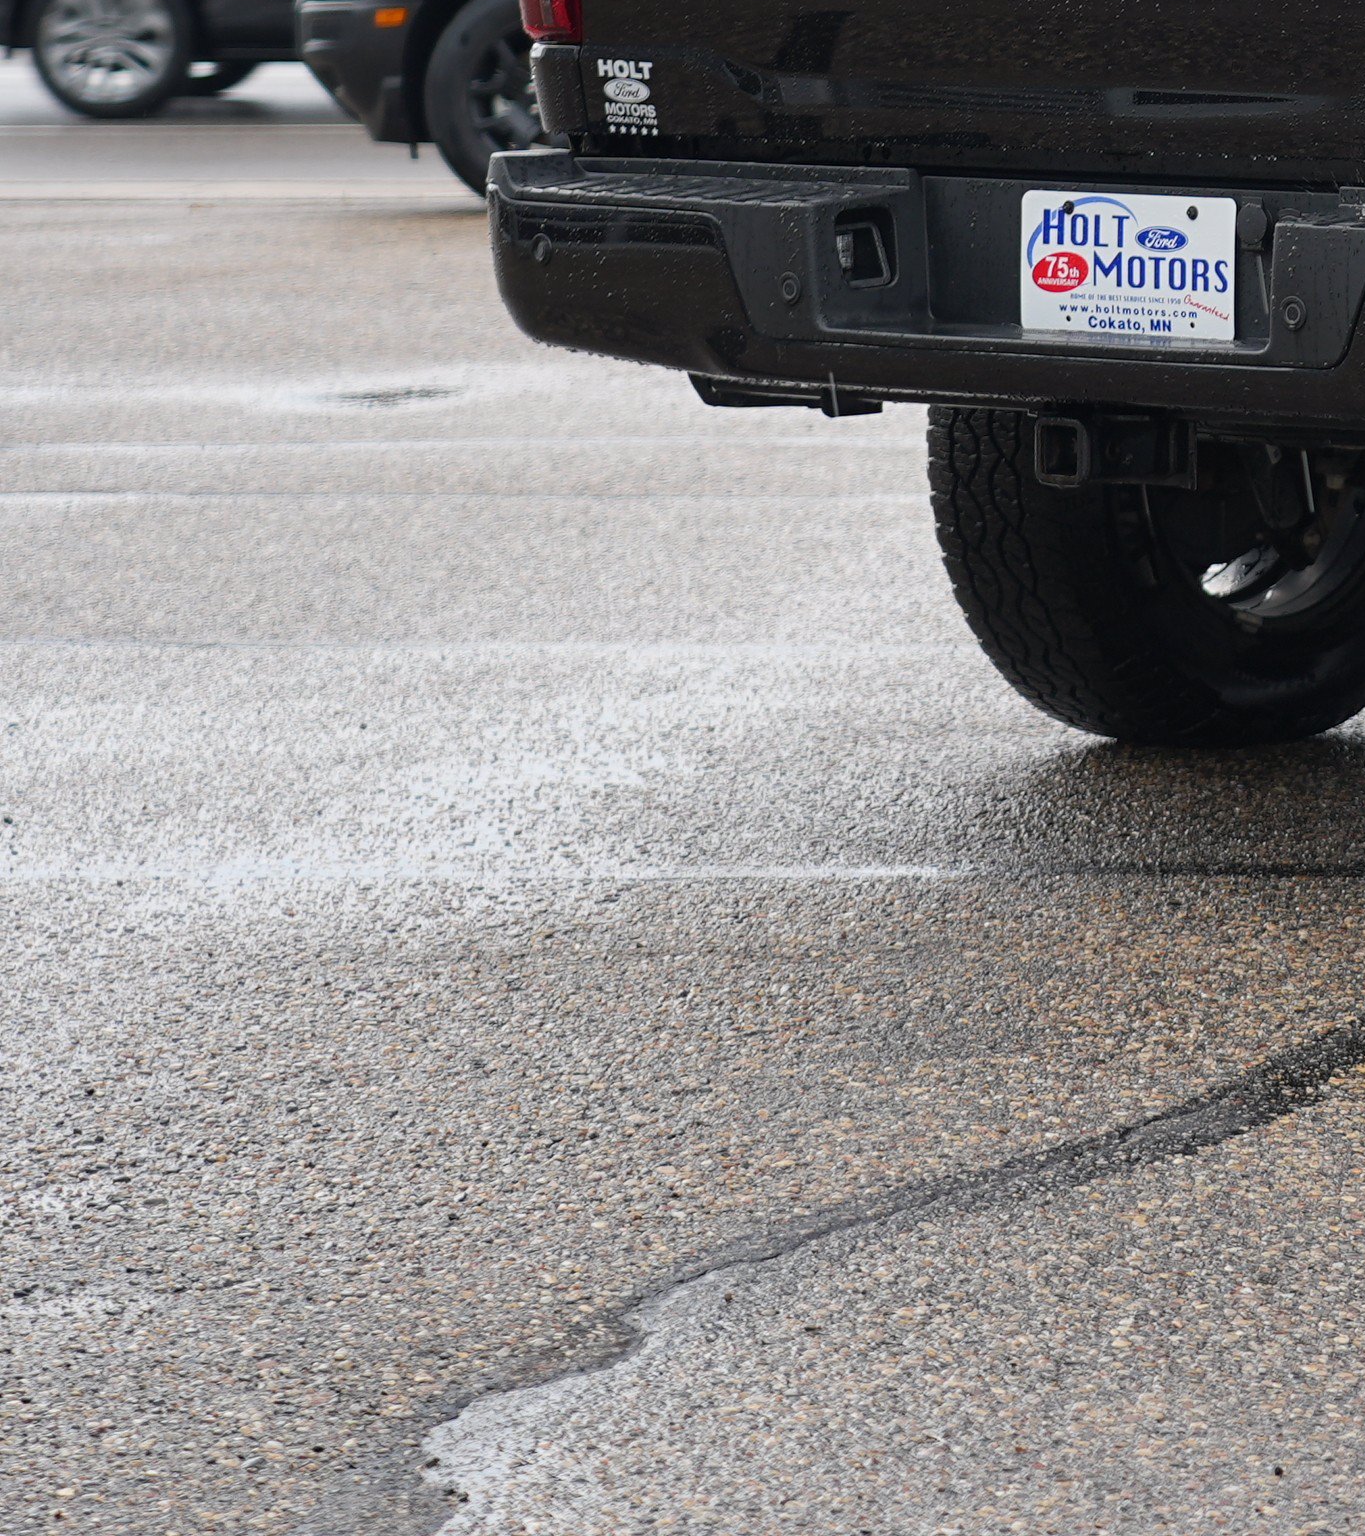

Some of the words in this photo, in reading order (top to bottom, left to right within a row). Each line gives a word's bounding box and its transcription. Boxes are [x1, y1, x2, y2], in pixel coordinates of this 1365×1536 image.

[597, 58, 653, 80] HOLT
[604, 101, 657, 118] MOTORS
[1042, 208, 1130, 248] HOLT
[1144, 228, 1179, 250] Ford
[1045, 256, 1080, 279] 75th
[1093, 251, 1229, 294] MOTORS
[1108, 294, 1122, 302] BEST
[1148, 296, 1165, 304] SINCE
[1059, 302, 1198, 319] www.holtmotors.com
[1088, 316, 1146, 334] Cokato,
[1150, 319, 1172, 332] MN
